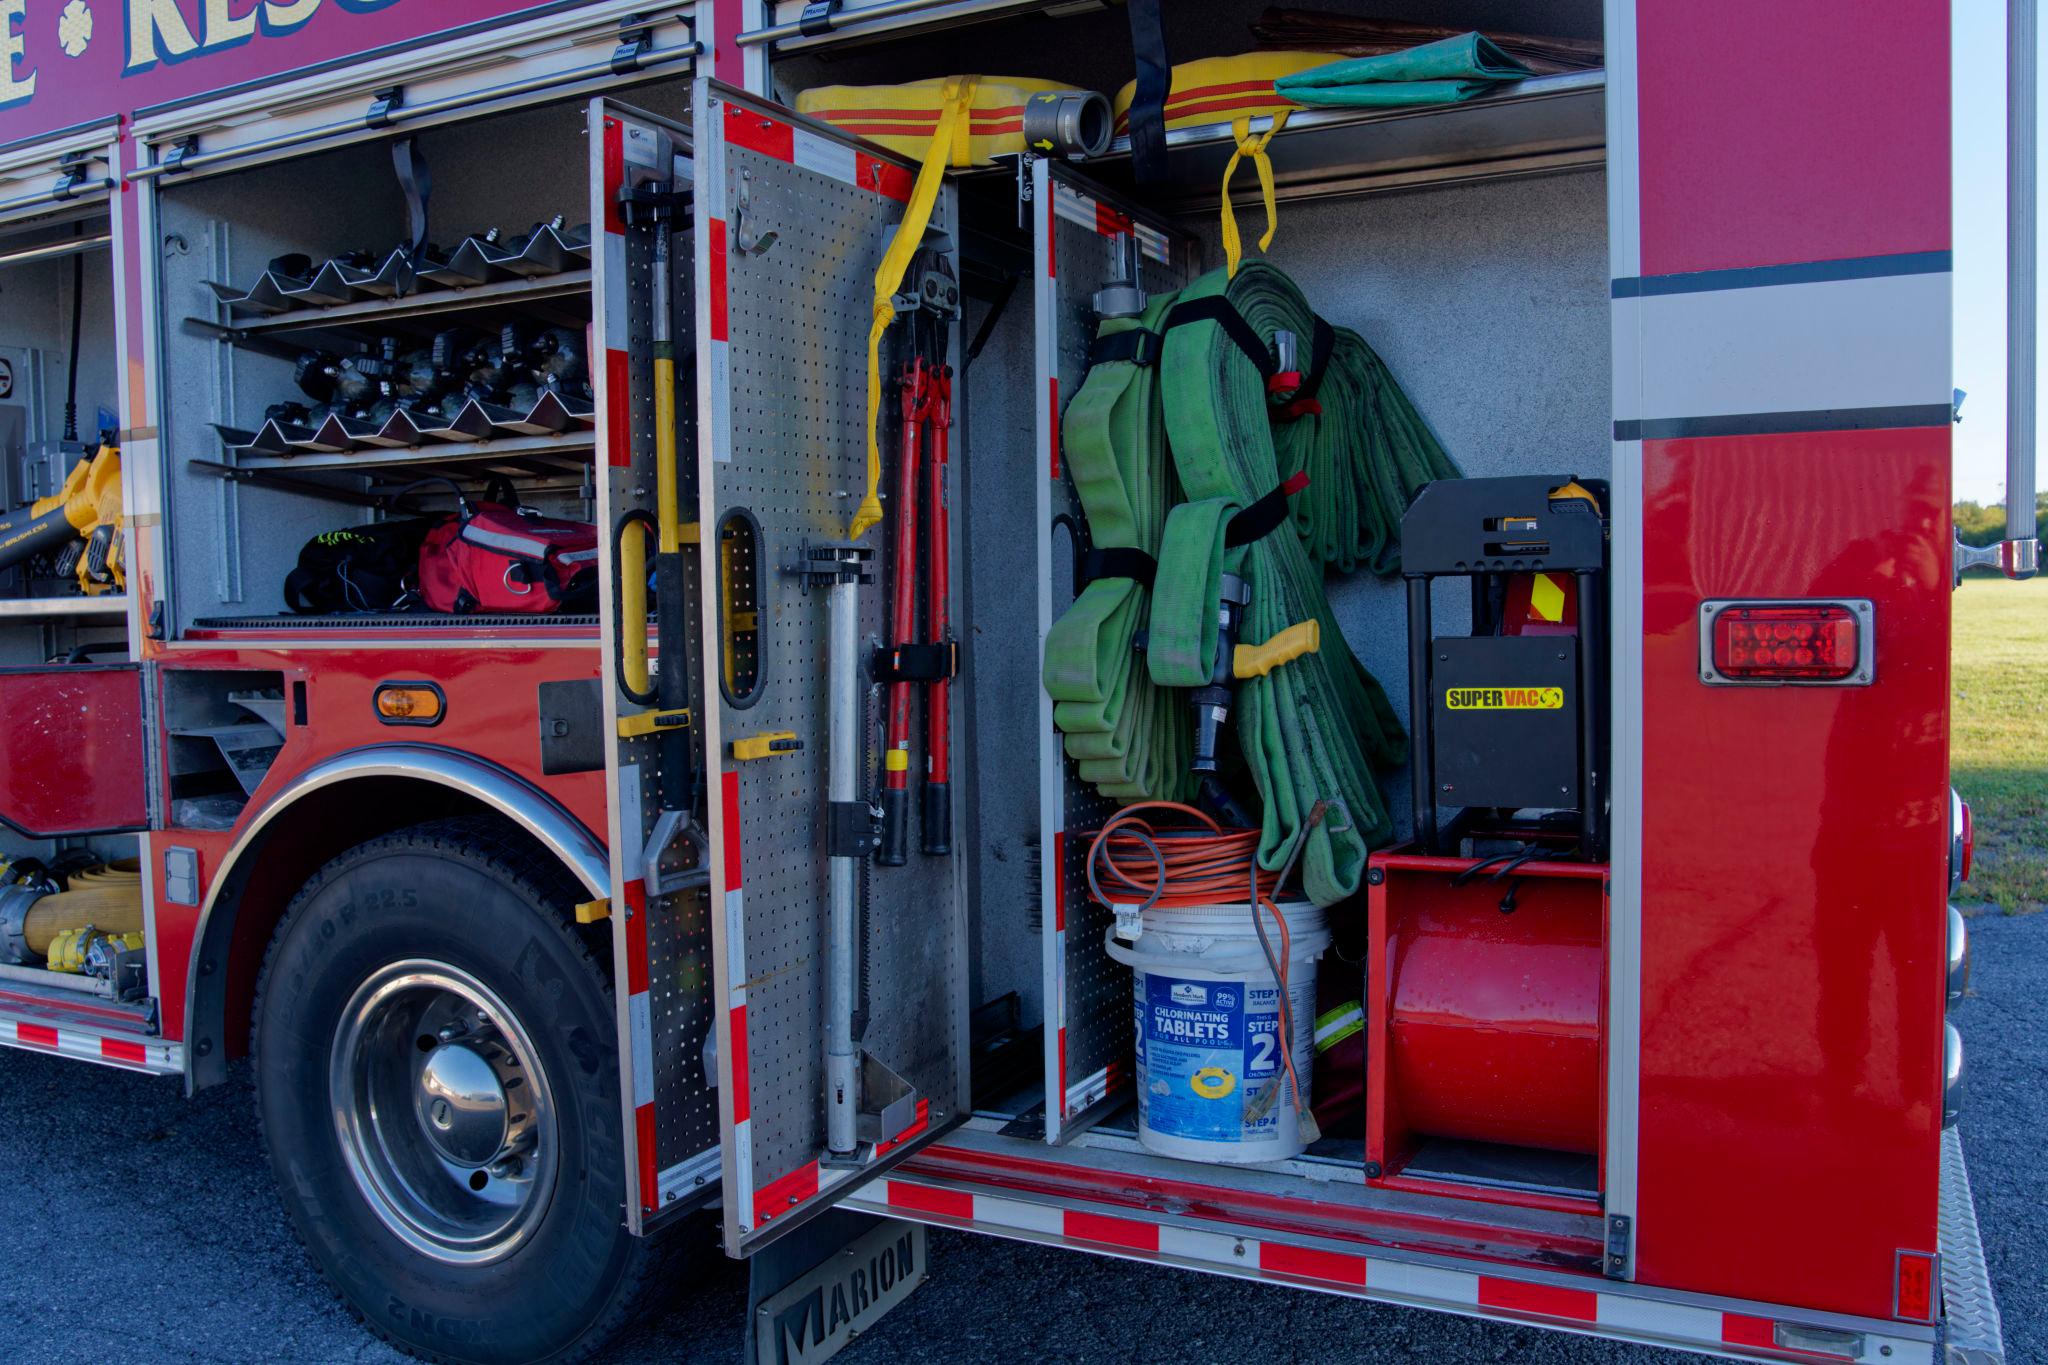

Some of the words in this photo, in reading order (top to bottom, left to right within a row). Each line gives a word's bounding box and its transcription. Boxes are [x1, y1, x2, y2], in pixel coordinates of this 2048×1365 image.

[364, 888, 418, 911] 22.5
[1217, 992, 1235, 1001] 99%
[1249, 990, 1274, 999] STEP
[1154, 1006, 1229, 1023] CHLORINATING
[1154, 1016, 1230, 1040] TABLETS
[1248, 1020, 1278, 1033] STEP
[1173, 1035, 1190, 1043] ALL
[1250, 1032, 1275, 1071] 2
[1270, 1117, 1277, 1125] 4
[774, 1231, 914, 1365] MARION
